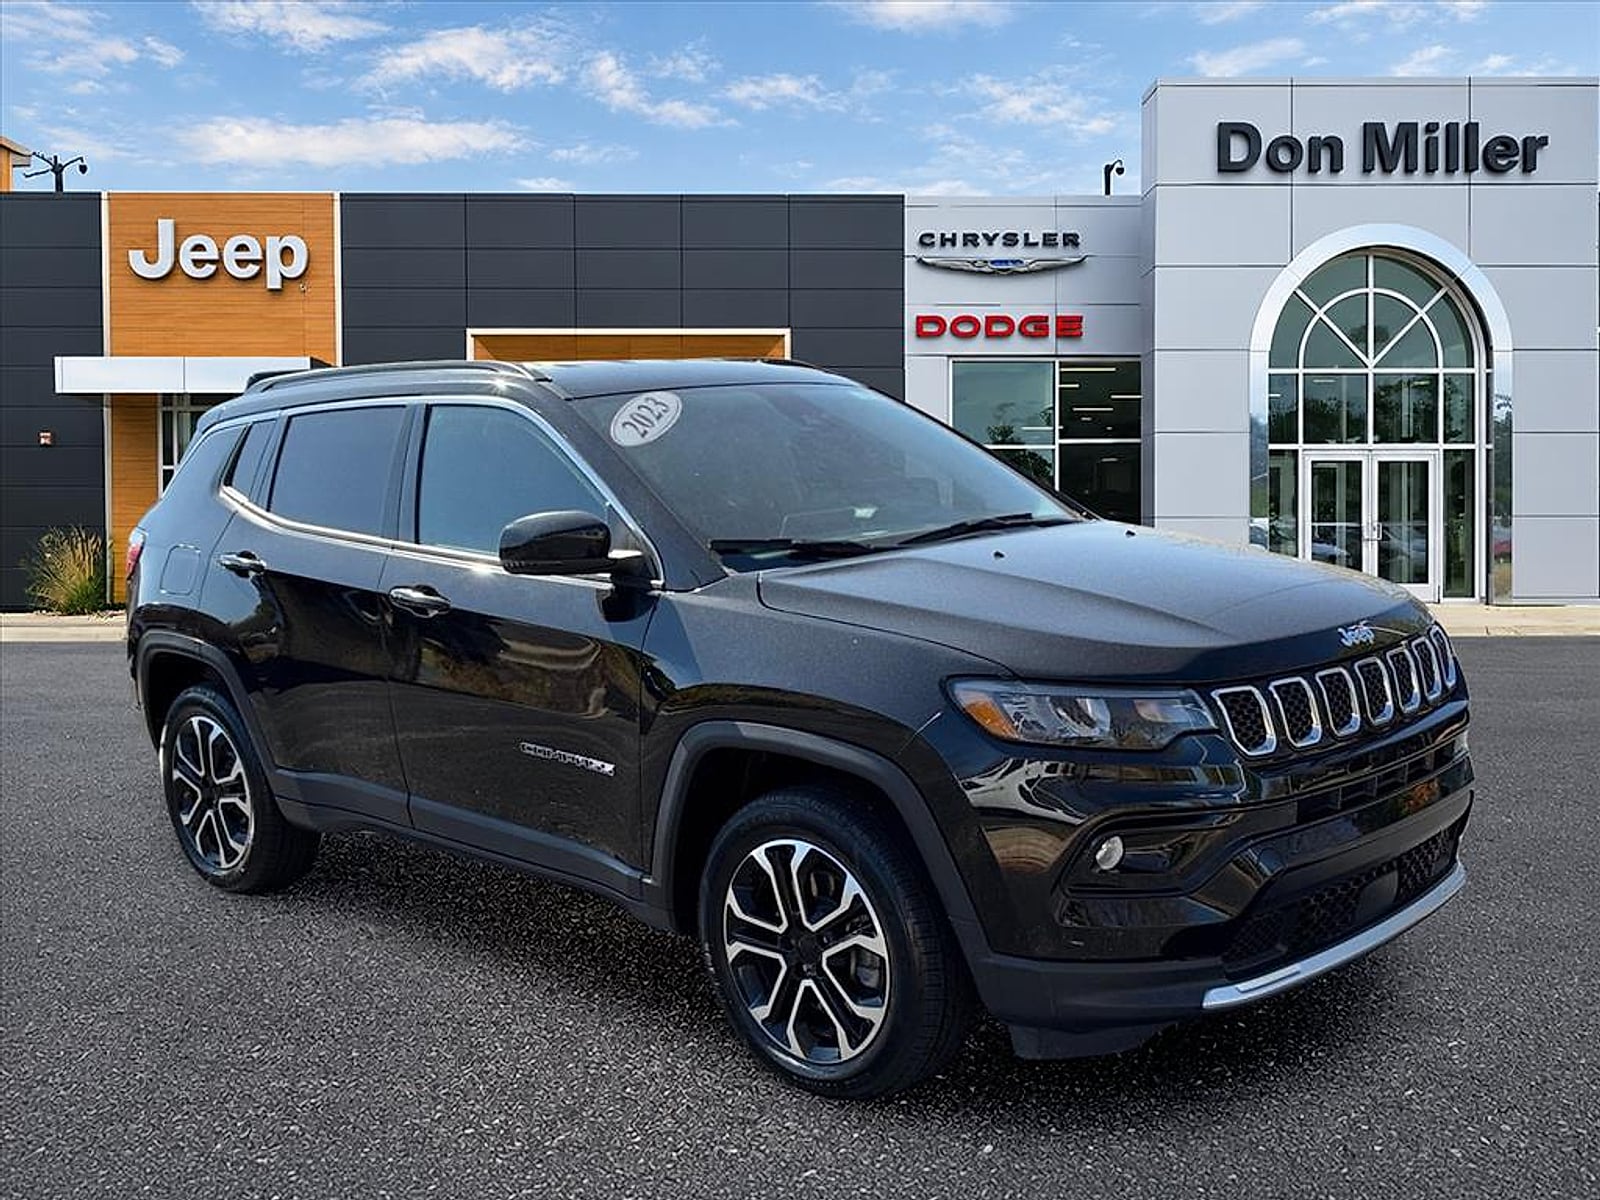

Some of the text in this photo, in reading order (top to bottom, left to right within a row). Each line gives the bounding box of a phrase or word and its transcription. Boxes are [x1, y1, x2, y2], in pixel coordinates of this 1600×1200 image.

[1217, 121, 1549, 174] Don Miller
[128, 218, 309, 290] Jeep
[918, 232, 1081, 248] CHRYSLER
[915, 315, 1083, 337] DODGE
[622, 396, 669, 438] 2023
